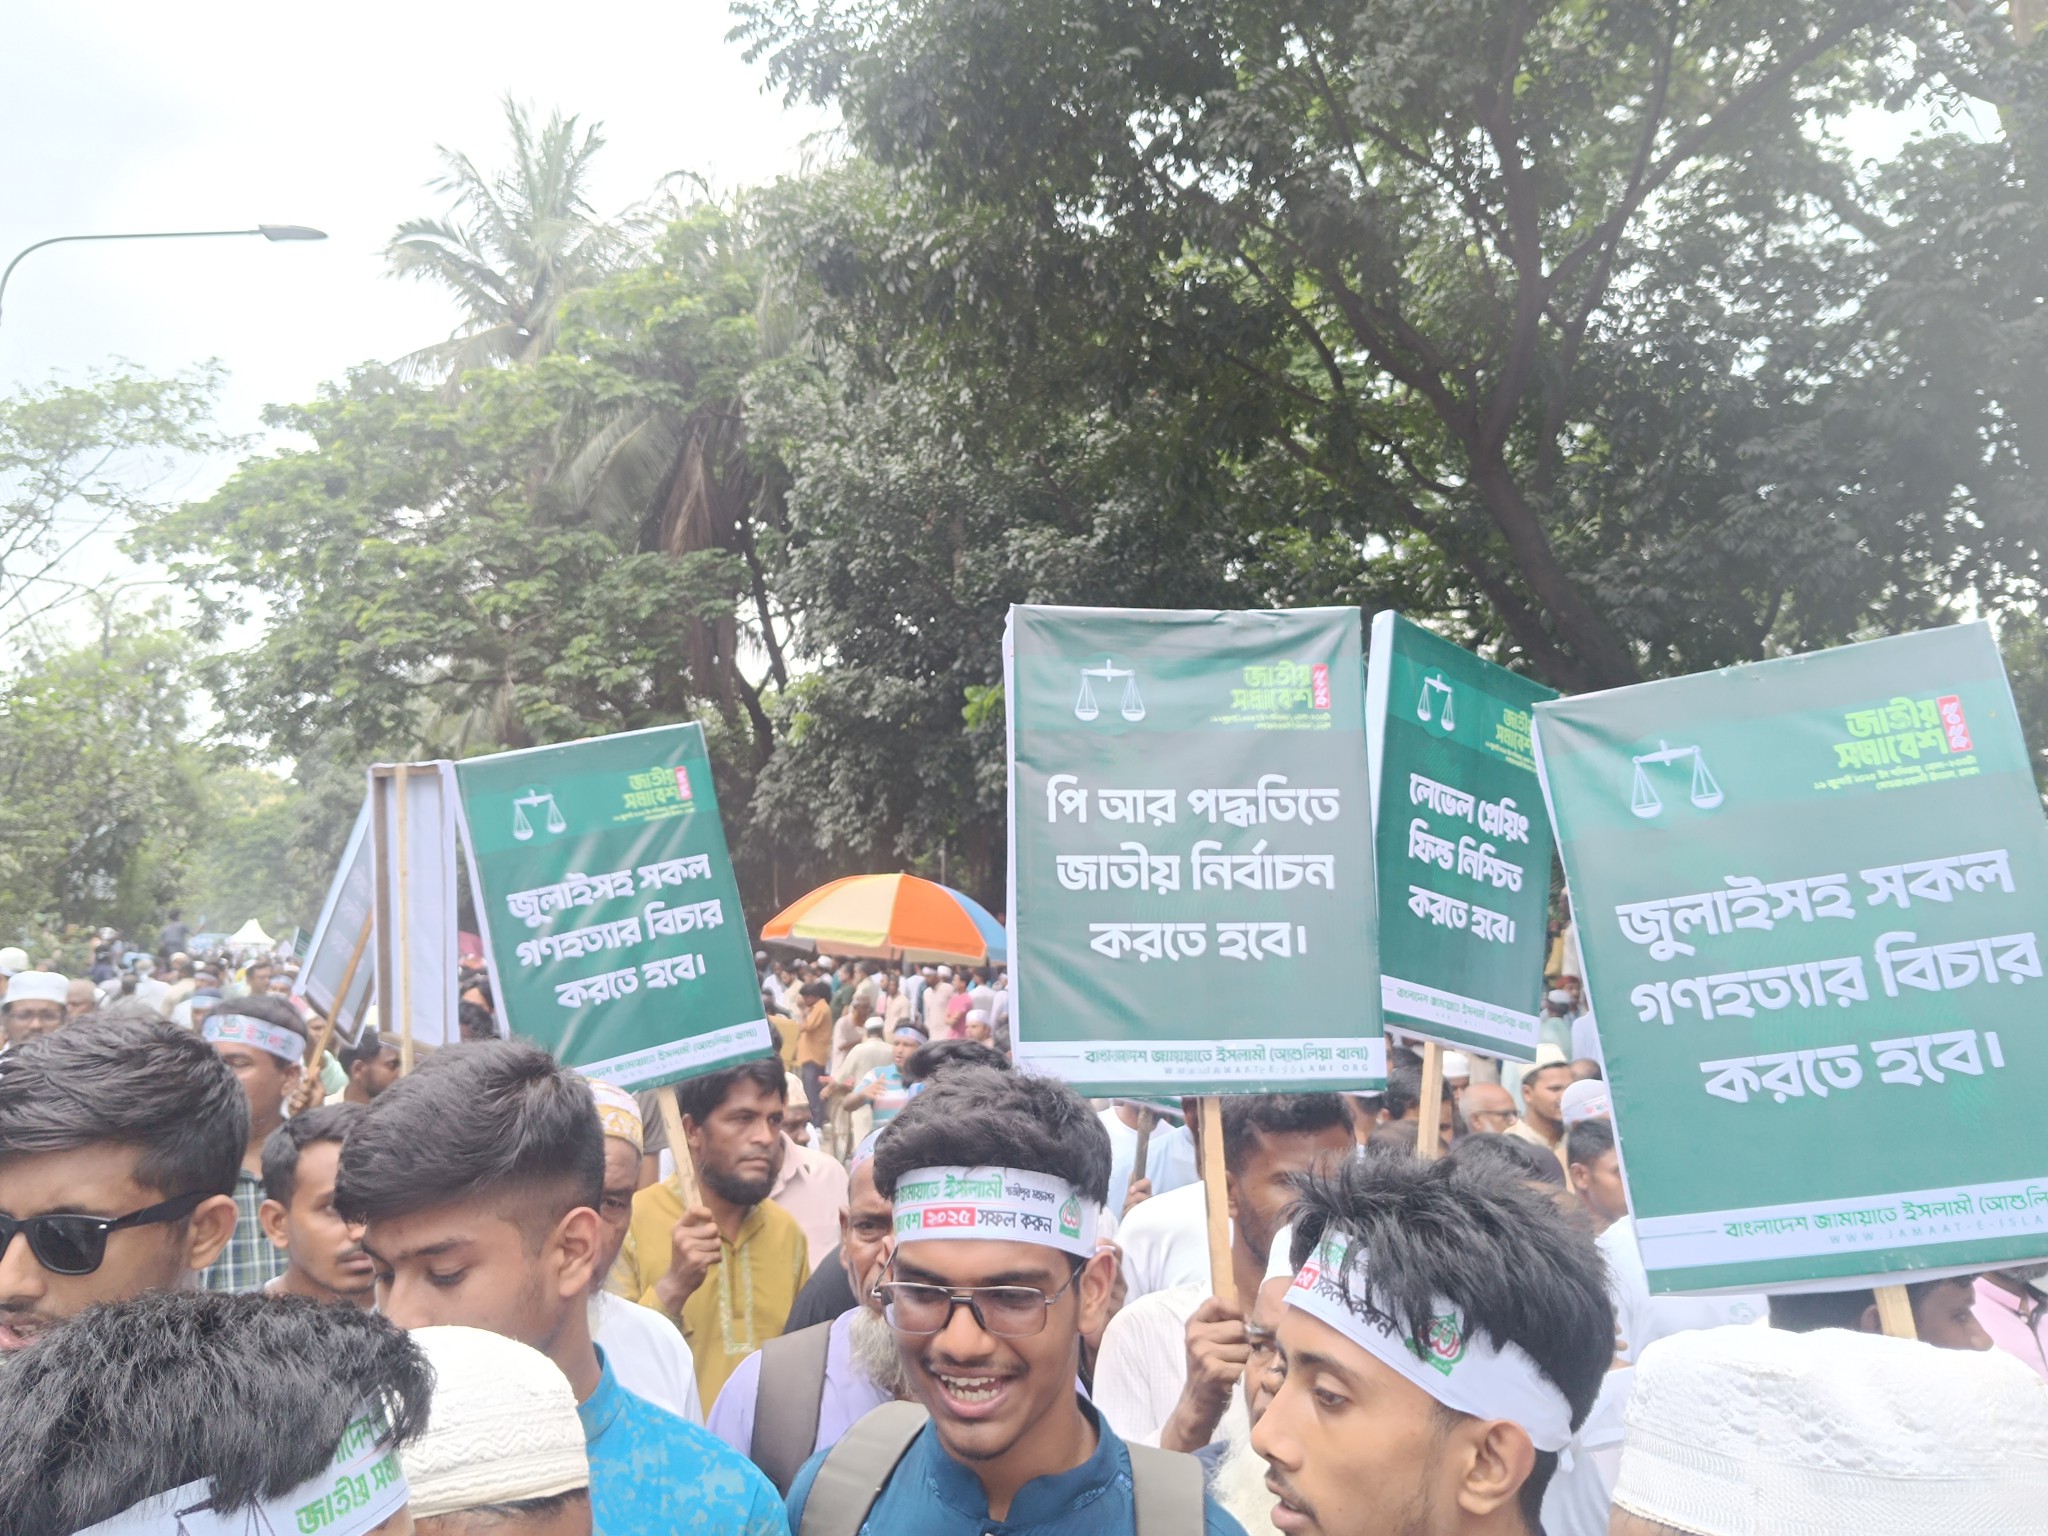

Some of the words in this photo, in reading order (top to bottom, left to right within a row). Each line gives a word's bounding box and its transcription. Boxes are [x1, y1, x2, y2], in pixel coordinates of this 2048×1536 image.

[1844, 697, 1941, 738] জাতীয়
[1833, 727, 1949, 769] সমাবেশ
[1047, 774, 1088, 823] পি
[1098, 789, 1176, 827] আর
[1187, 774, 1340, 828] পদ্ধতিতে
[1410, 773, 1475, 823] লেভেল
[1478, 797, 1529, 844] প্লেয়িং
[1056, 841, 1180, 895] জাতীয়
[1191, 838, 1335, 890] নির্বাচন
[1408, 818, 1456, 870] ফিল্ড
[1457, 835, 1523, 892] নিশ্চিত
[506, 872, 635, 927] জুলাইসহ
[637, 853, 711, 890] সকল
[1408, 885, 1469, 929] করতে
[1615, 873, 1856, 961] জুলাইসহ
[1859, 849, 2016, 908] সকল
[516, 917, 642, 967] গণহত্যার
[644, 899, 724, 940] বিচার
[1089, 923, 1207, 963] করতে
[555, 967, 638, 1009] করতে
[1630, 956, 1869, 1025] গণহত্যার
[1874, 930, 2044, 997] বিচার
[1216, 1045, 1266, 1062] ইসলামী
[1700, 1044, 1863, 1103] করতে
[944, 1173, 1003, 1199] ইসলামী
[926, 1209, 972, 1226] ২০২৫
[977, 1209, 1017, 1228] সফল
[1020, 1213, 1052, 1234] করুন
[1723, 1216, 1809, 1238] বাংলাদেশ
[1813, 1207, 1898, 1230] জামায়াতে
[1902, 1194, 1974, 1221] ইসলামী
[294, 1475, 372, 1535] জাতীয়
